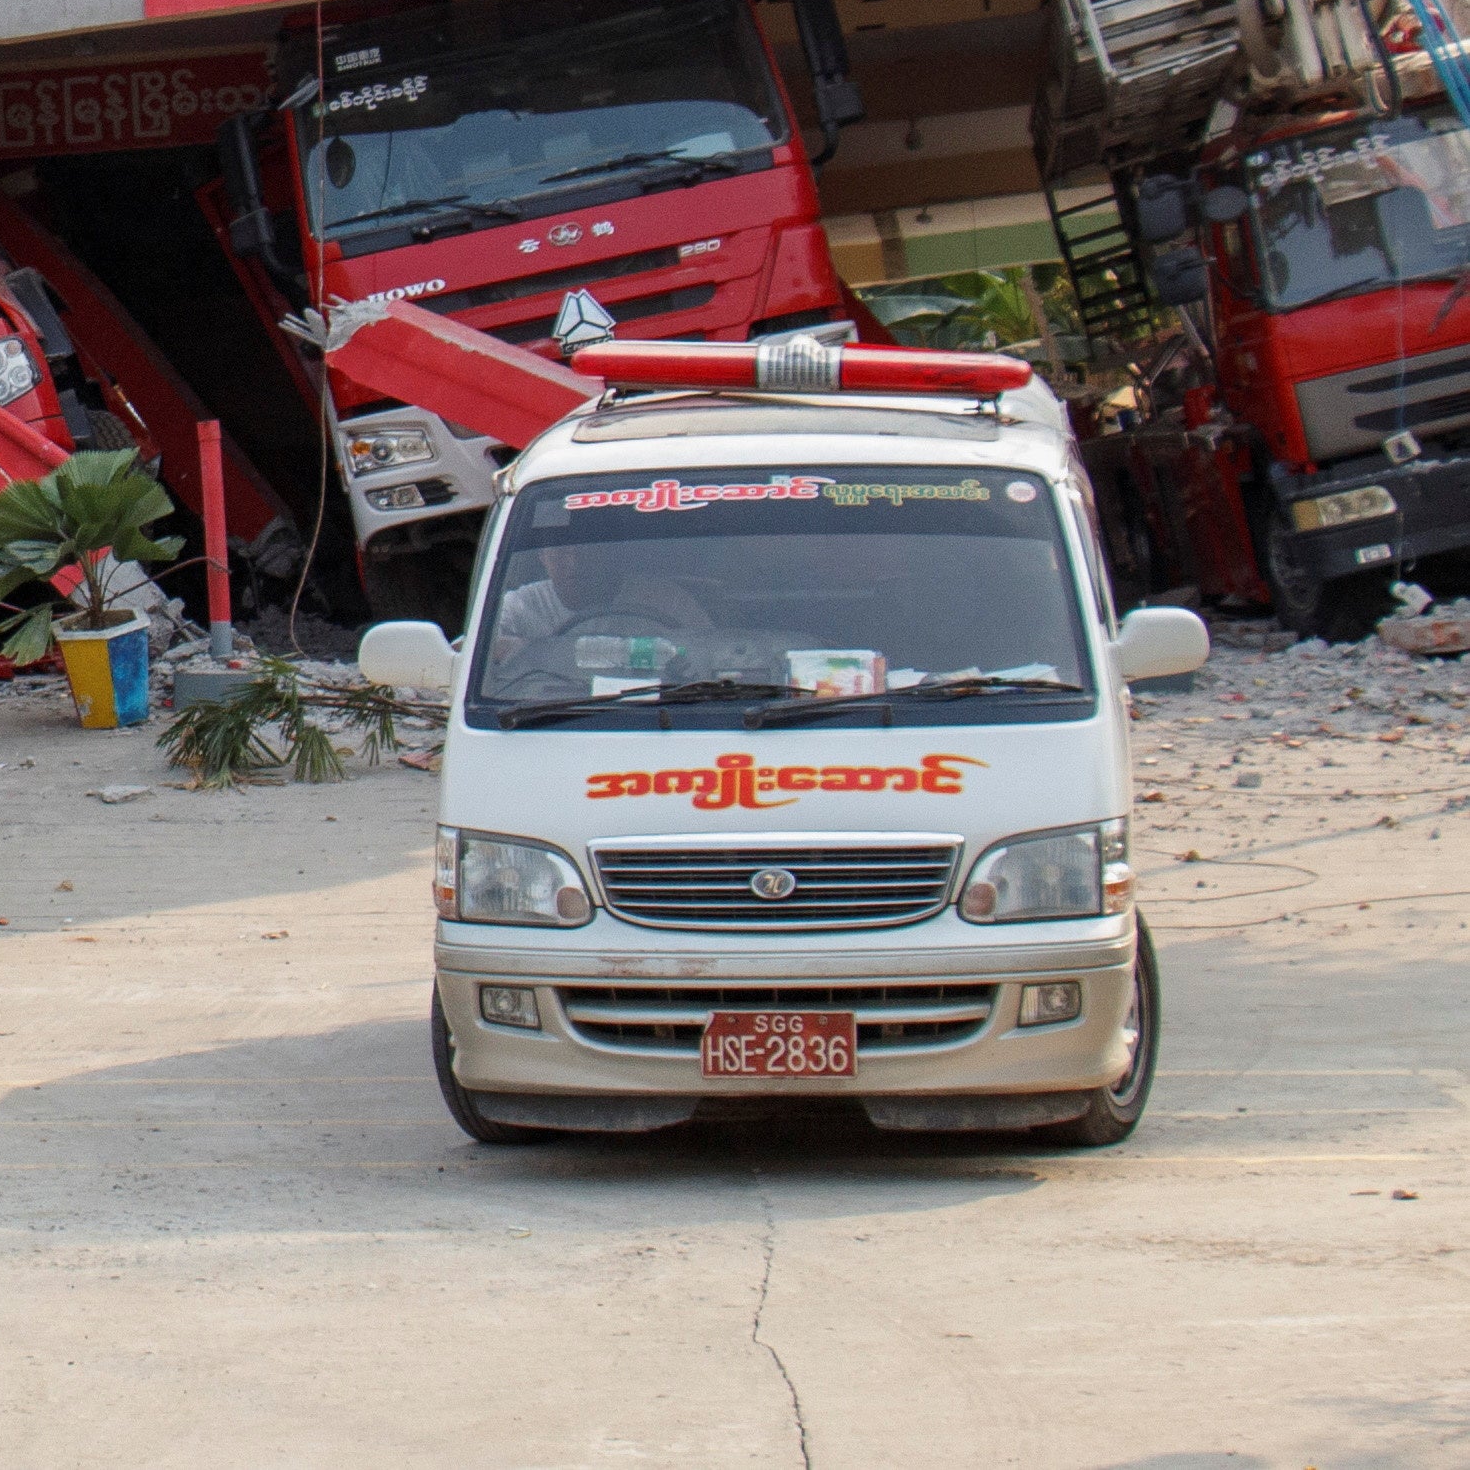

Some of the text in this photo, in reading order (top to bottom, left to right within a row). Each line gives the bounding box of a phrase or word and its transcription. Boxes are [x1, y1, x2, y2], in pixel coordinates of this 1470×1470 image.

[366, 278, 446, 305] HOWO
[586, 752, 991, 811] အကျိုးဆောင်
[754, 1014, 804, 1033] SGG
[707, 1034, 849, 1073] HSE-2836
